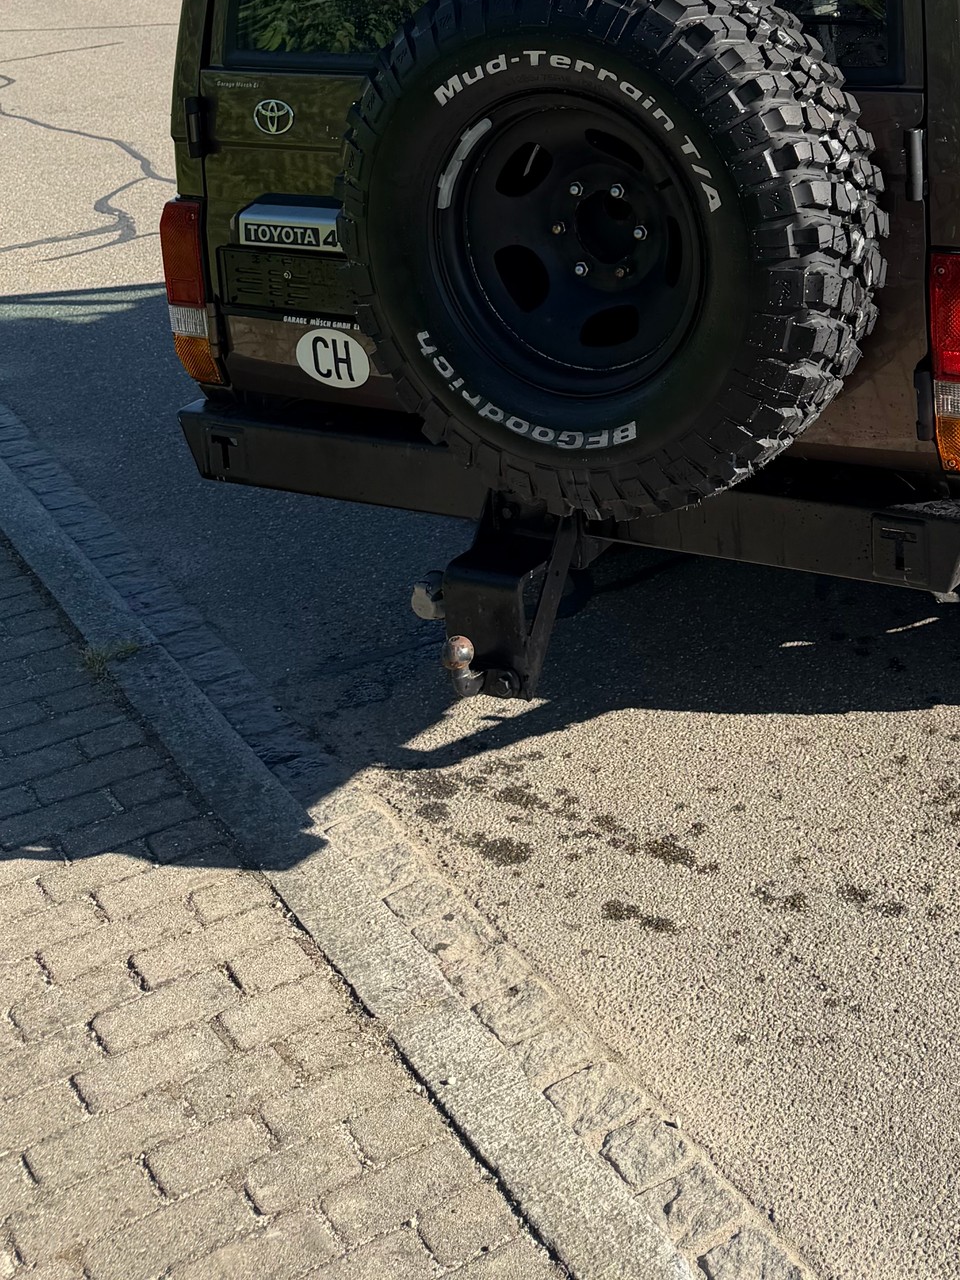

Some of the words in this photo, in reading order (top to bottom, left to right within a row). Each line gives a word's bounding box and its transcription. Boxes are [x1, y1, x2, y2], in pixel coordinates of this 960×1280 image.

[432, 49, 675, 132] Mud-Terrain
[680, 134, 722, 213] T/A
[246, 224, 318, 246] TOYOTA
[283, 315, 307, 325] GARAGE
[309, 317, 332, 328] MÖSCH
[311, 335, 356, 382] CH
[416, 330, 638, 449] BFGoodrich
